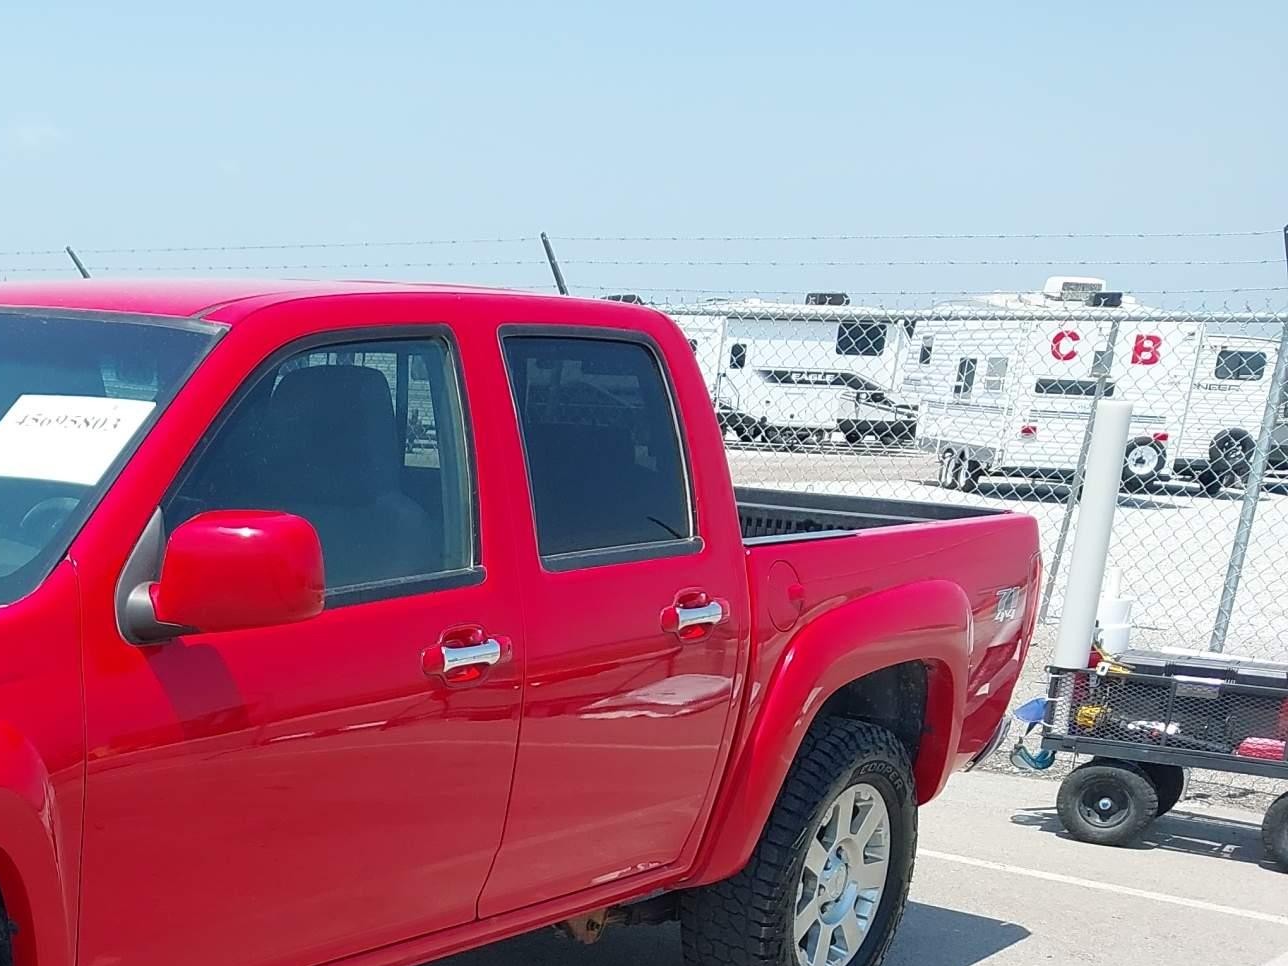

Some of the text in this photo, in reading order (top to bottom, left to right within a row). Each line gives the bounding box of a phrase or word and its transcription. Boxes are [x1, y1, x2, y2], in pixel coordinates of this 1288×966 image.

[1051, 330, 1162, 365] C B
[791, 372, 835, 381] EAGLE
[859, 761, 904, 791] COOPER
